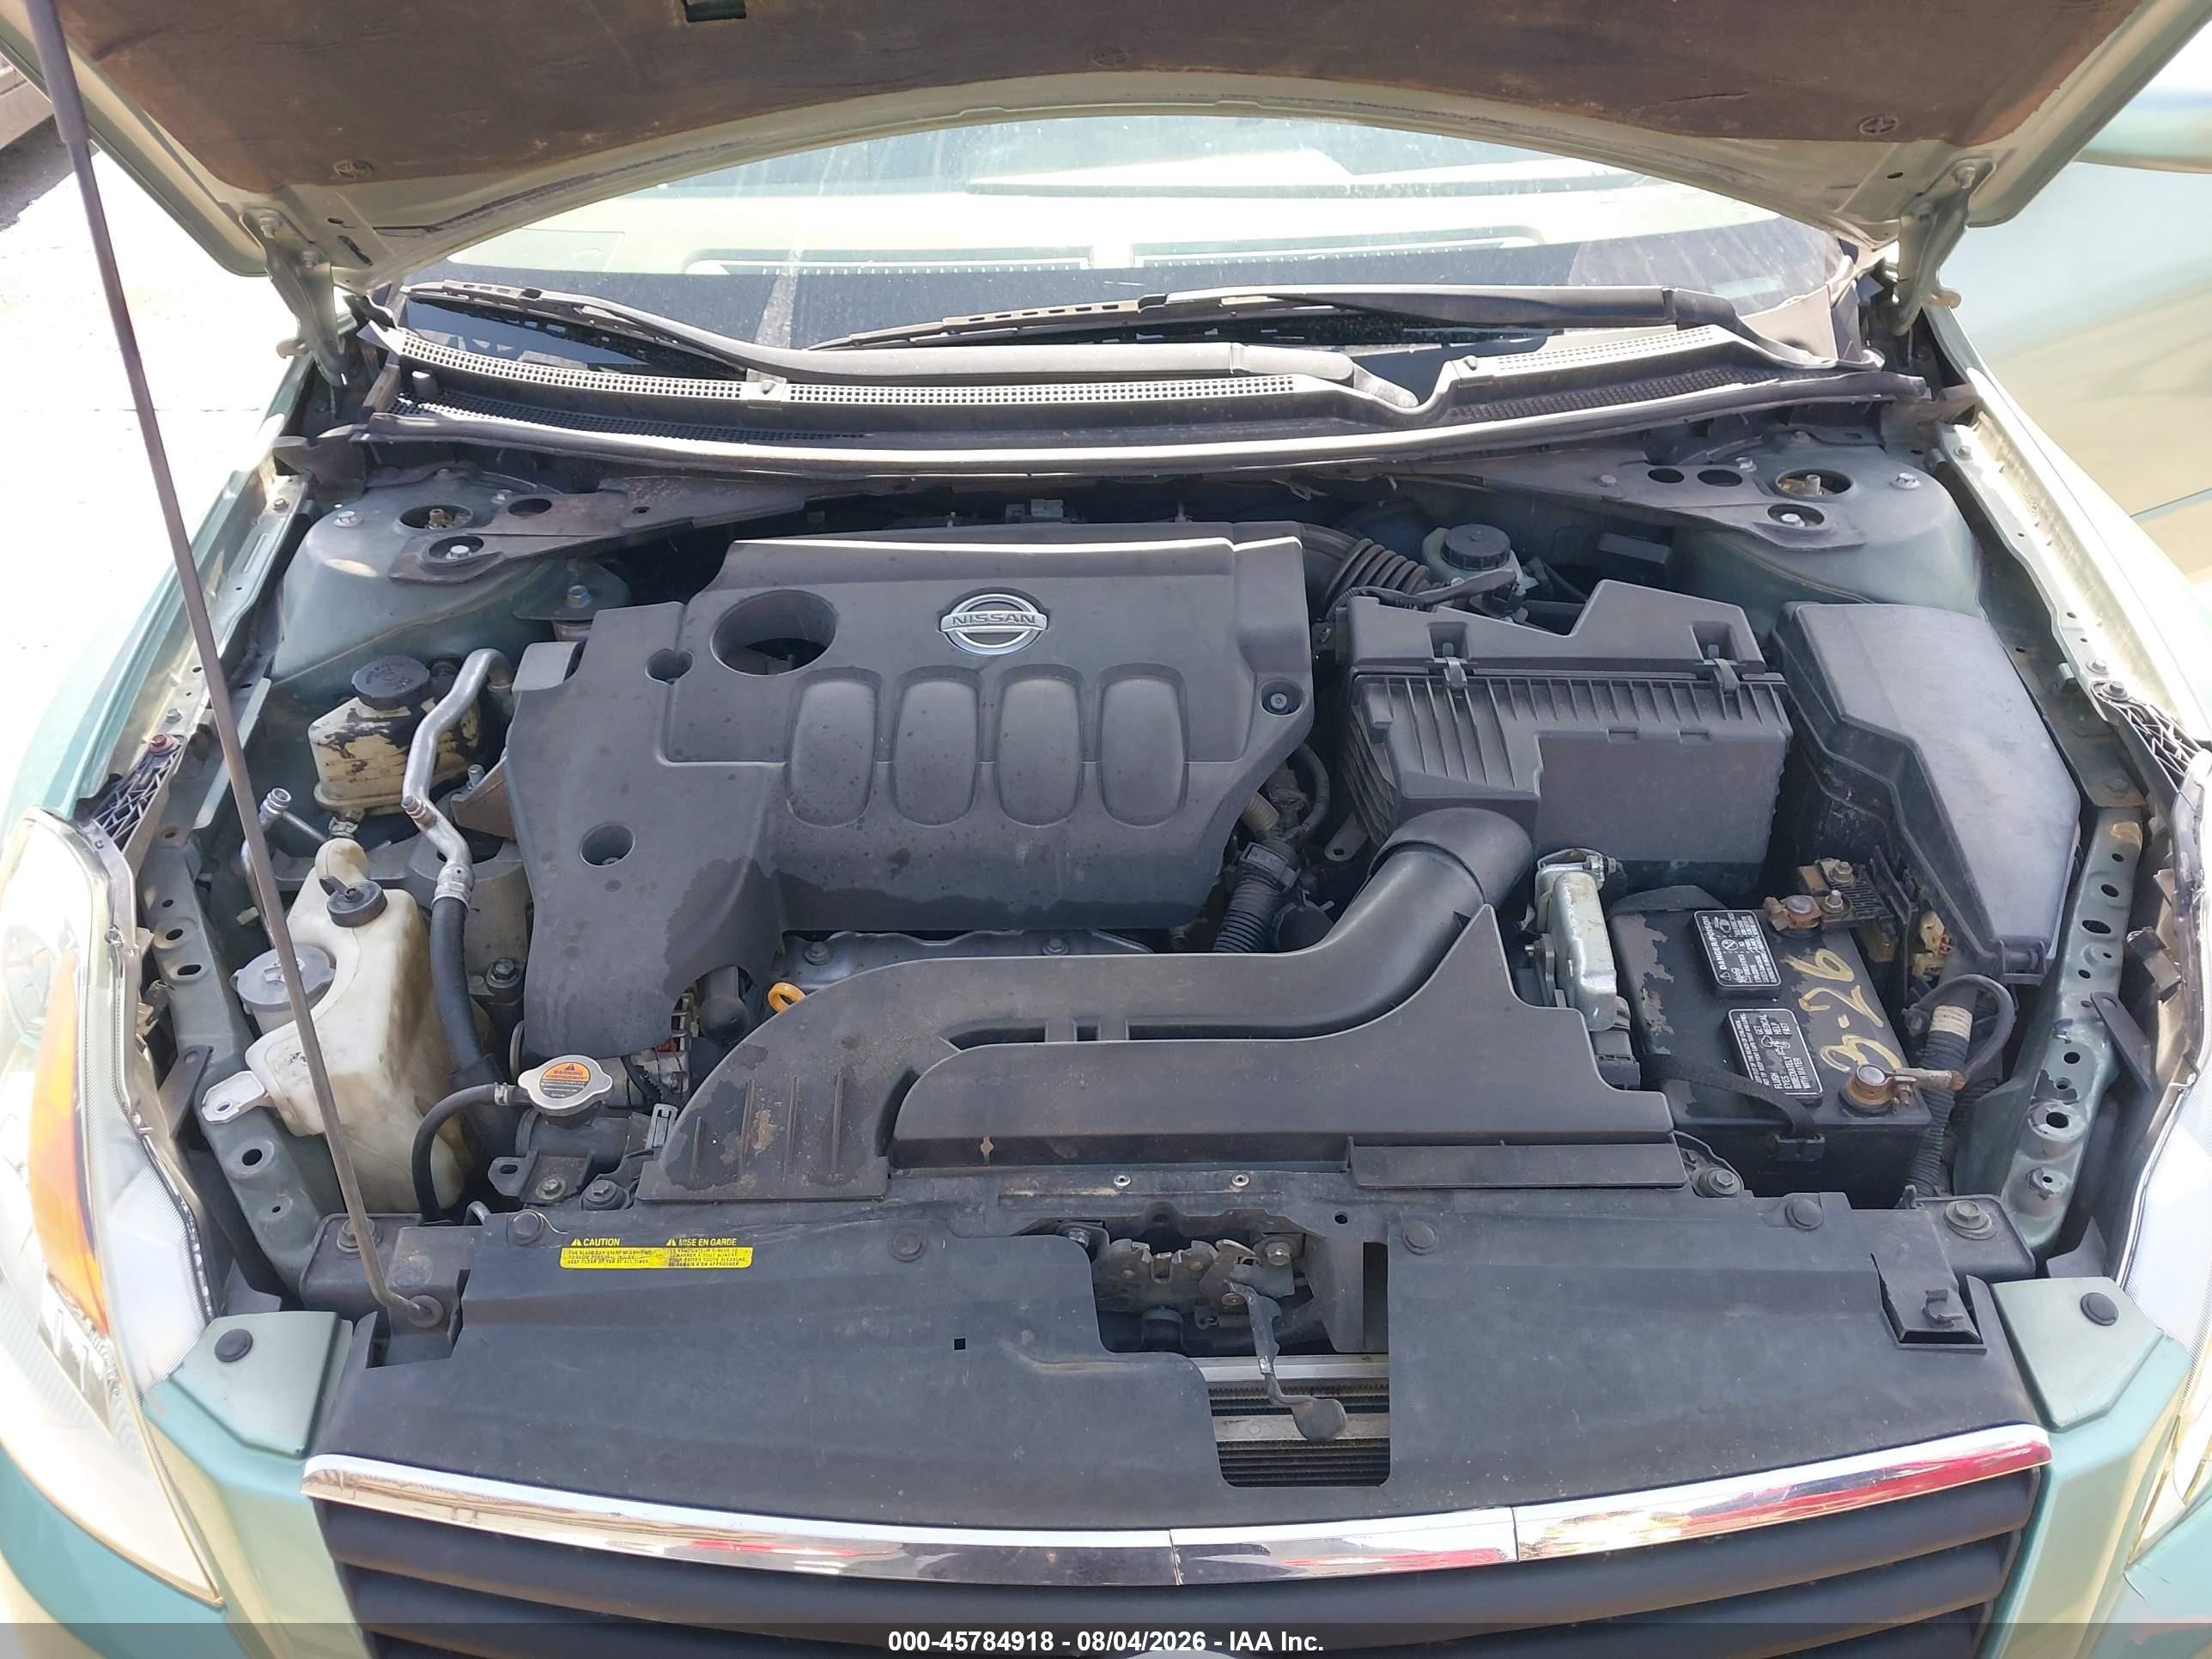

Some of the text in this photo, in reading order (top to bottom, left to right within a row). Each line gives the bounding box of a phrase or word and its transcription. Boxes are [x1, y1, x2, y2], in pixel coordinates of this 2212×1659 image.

[952, 612, 1036, 626] NISSAN
[1701, 915, 1727, 970] DANGER/POISON
[1753, 1025, 1764, 1036] GET
[1758, 1013, 1773, 1035] MEDICAL
[1771, 1022, 1782, 1035] HELP
[1779, 1023, 1792, 1035] FAST
[1783, 1056, 1802, 1089] IMMEDIATELY
[1793, 1057, 1812, 1089] WITH WATER
[1770, 1073, 1783, 1090] FLUSH
[1780, 1075, 1793, 1090] EYES
